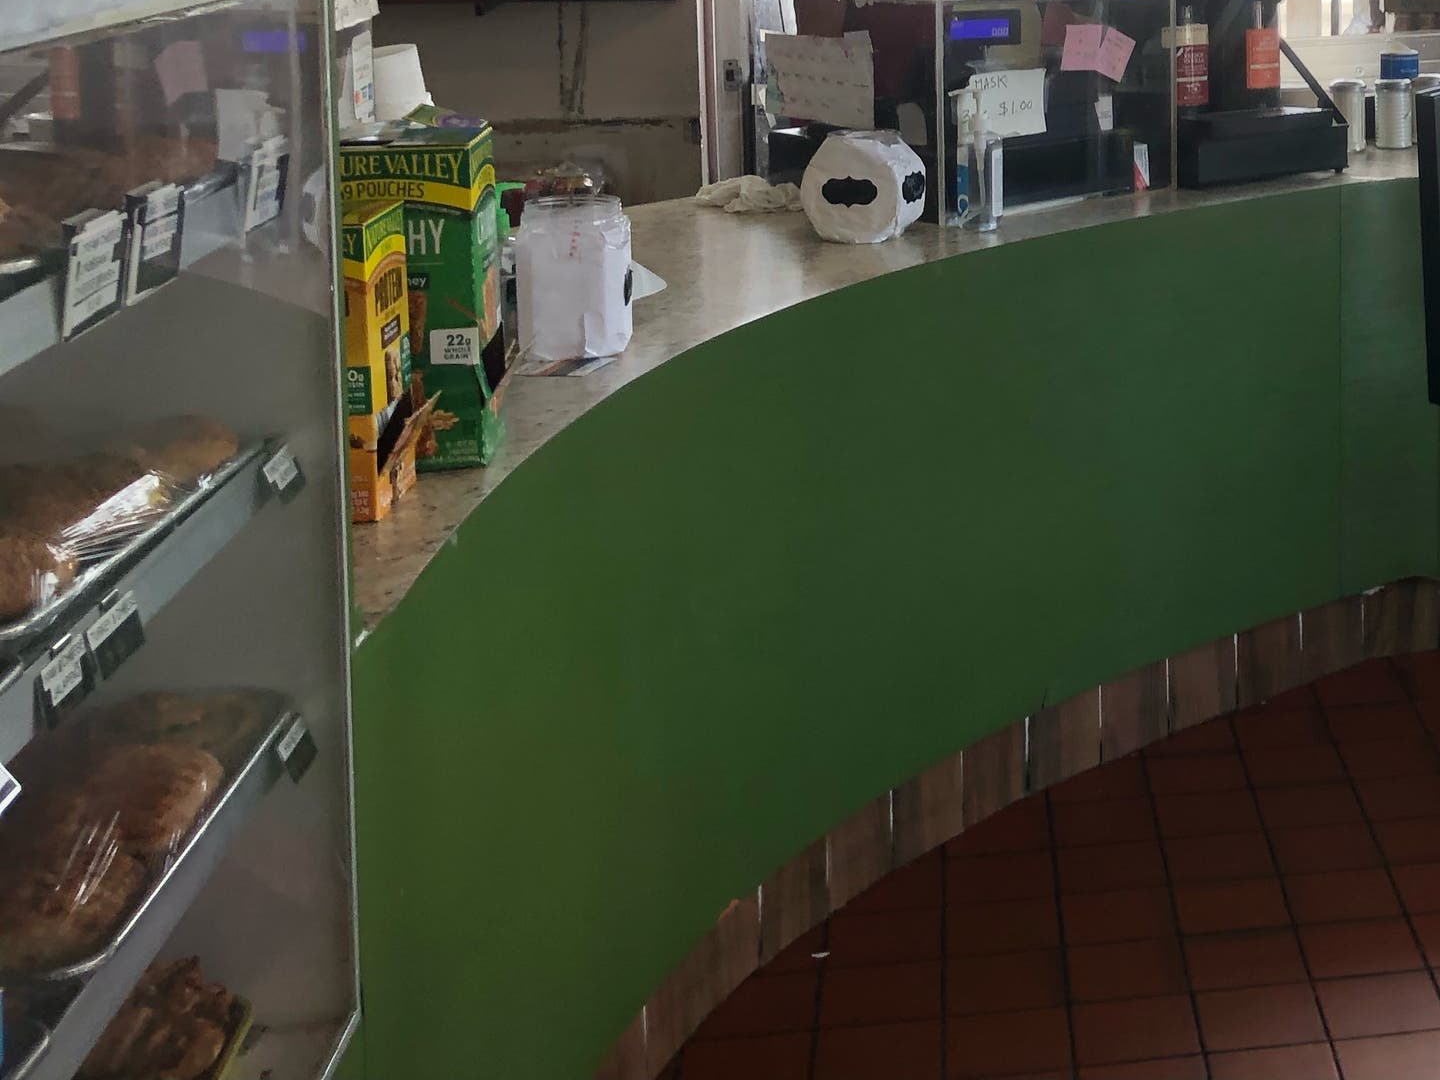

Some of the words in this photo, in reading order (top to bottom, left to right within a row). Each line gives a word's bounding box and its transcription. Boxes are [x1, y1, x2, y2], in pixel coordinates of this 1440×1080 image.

[974, 75, 1008, 91] MASK
[999, 100, 1034, 117] $1.00
[340, 154, 380, 176] URE
[384, 152, 463, 185] VALLEY
[357, 181, 425, 199] POUCHES
[446, 334, 471, 347] 22g
